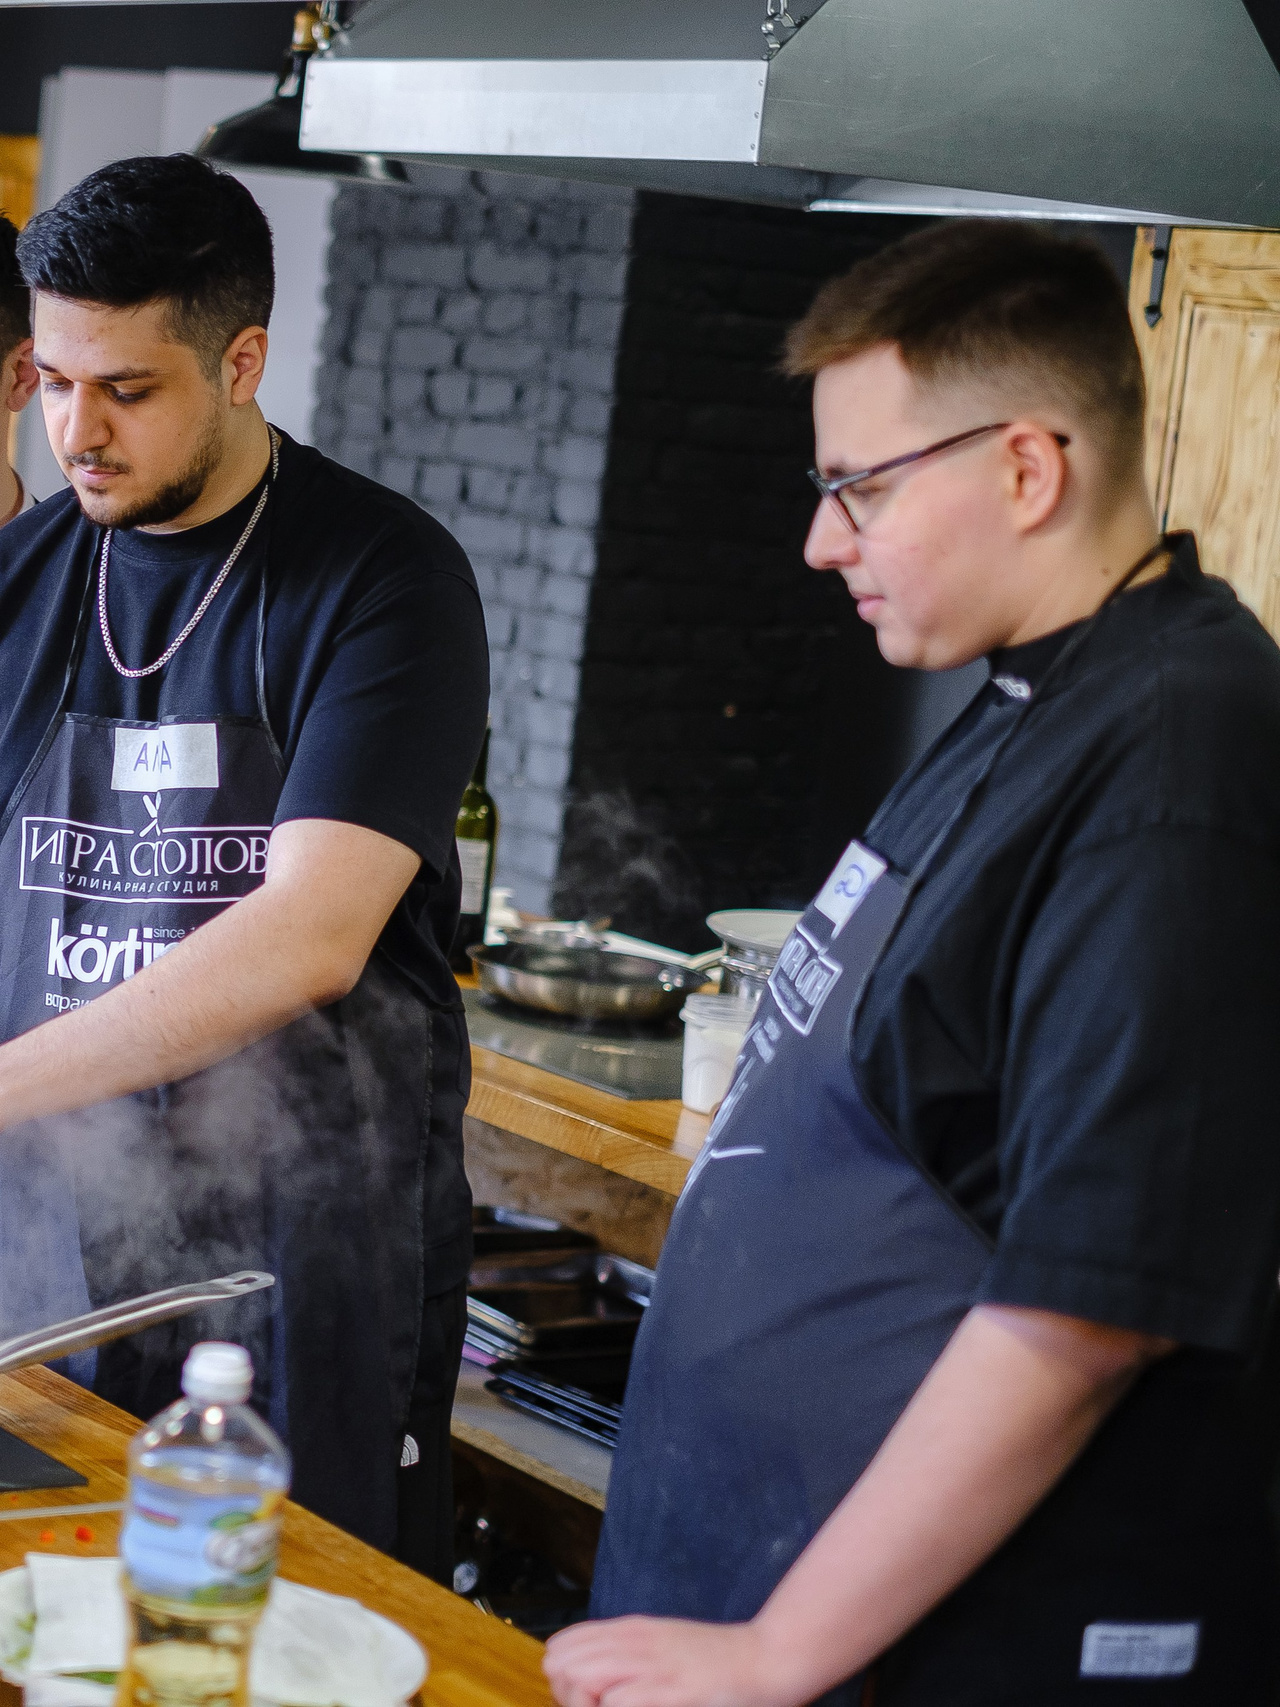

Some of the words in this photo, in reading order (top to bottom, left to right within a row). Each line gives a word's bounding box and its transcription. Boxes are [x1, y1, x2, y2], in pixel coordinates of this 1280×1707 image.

[30, 827, 120, 875] ИГРА
[129, 837, 269, 877] СТОЛОВ
[156, 880, 219, 894] СТУДИЯ
[153, 926, 186, 939] since
[47, 917, 181, 984] körti
